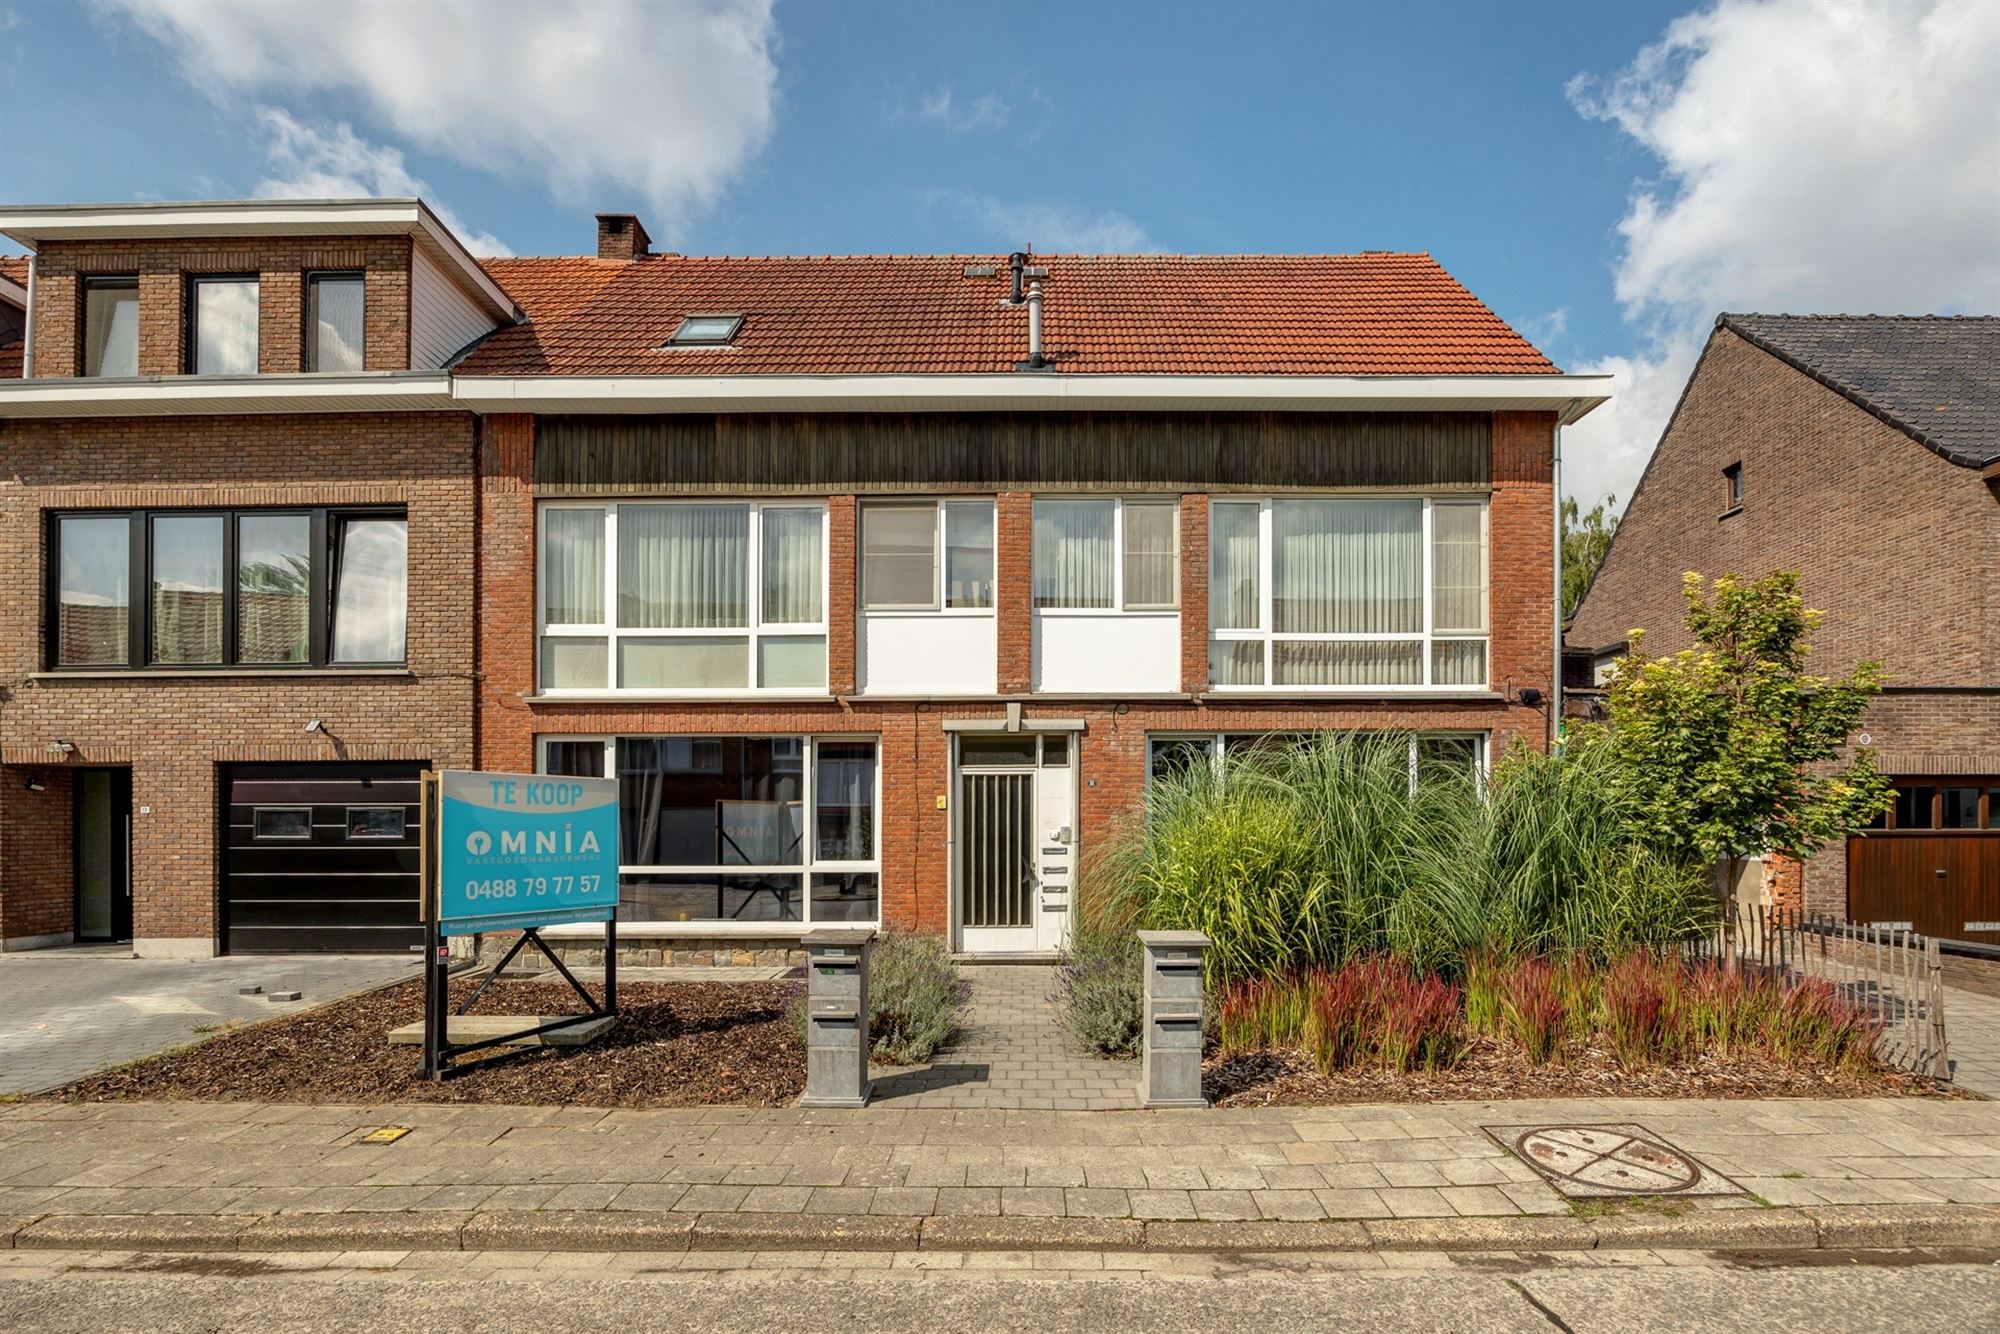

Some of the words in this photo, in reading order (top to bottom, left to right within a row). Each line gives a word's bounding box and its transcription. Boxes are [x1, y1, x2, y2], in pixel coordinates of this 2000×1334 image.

[489, 780, 517, 804] TE
[526, 782, 584, 806] KOOP
[465, 879, 517, 900] 0488
[523, 878, 547, 897] 79
[552, 876, 574, 895] 77
[580, 875, 601, 893] 57
